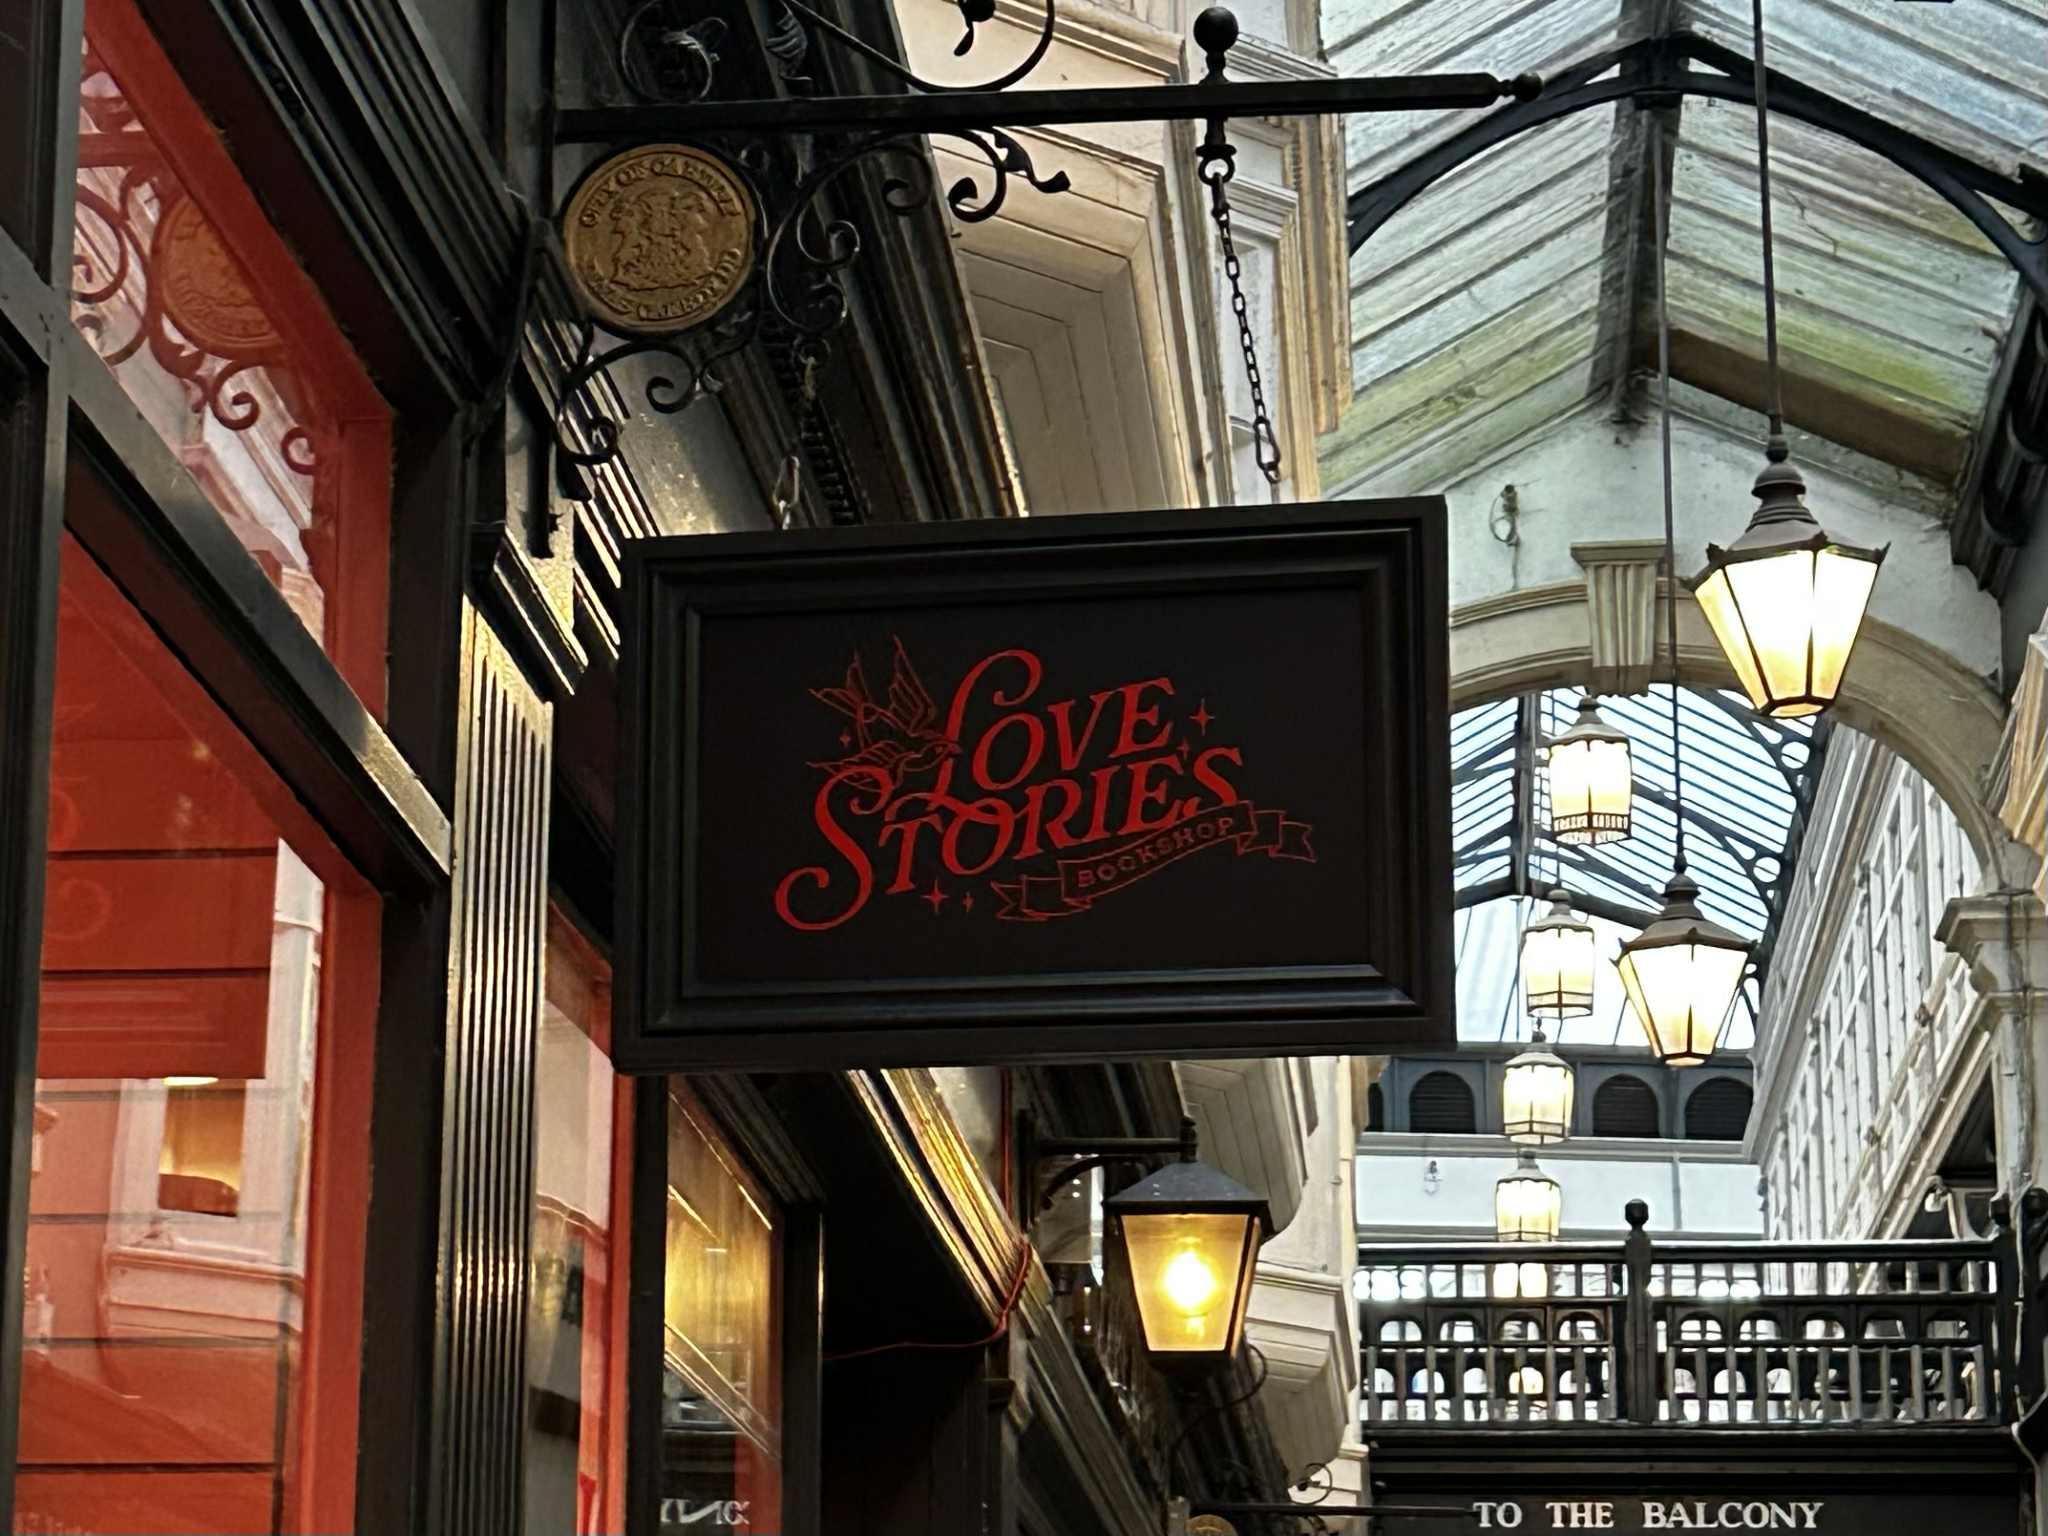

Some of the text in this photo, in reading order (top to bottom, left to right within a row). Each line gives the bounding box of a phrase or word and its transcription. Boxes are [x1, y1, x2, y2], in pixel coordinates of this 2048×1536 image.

[920, 649, 1177, 806] LOVE
[775, 745, 1243, 931] STORIES
[1077, 817, 1233, 887] BOOKSHOP
[1473, 1502, 1824, 1528] TO THE BALCONY
